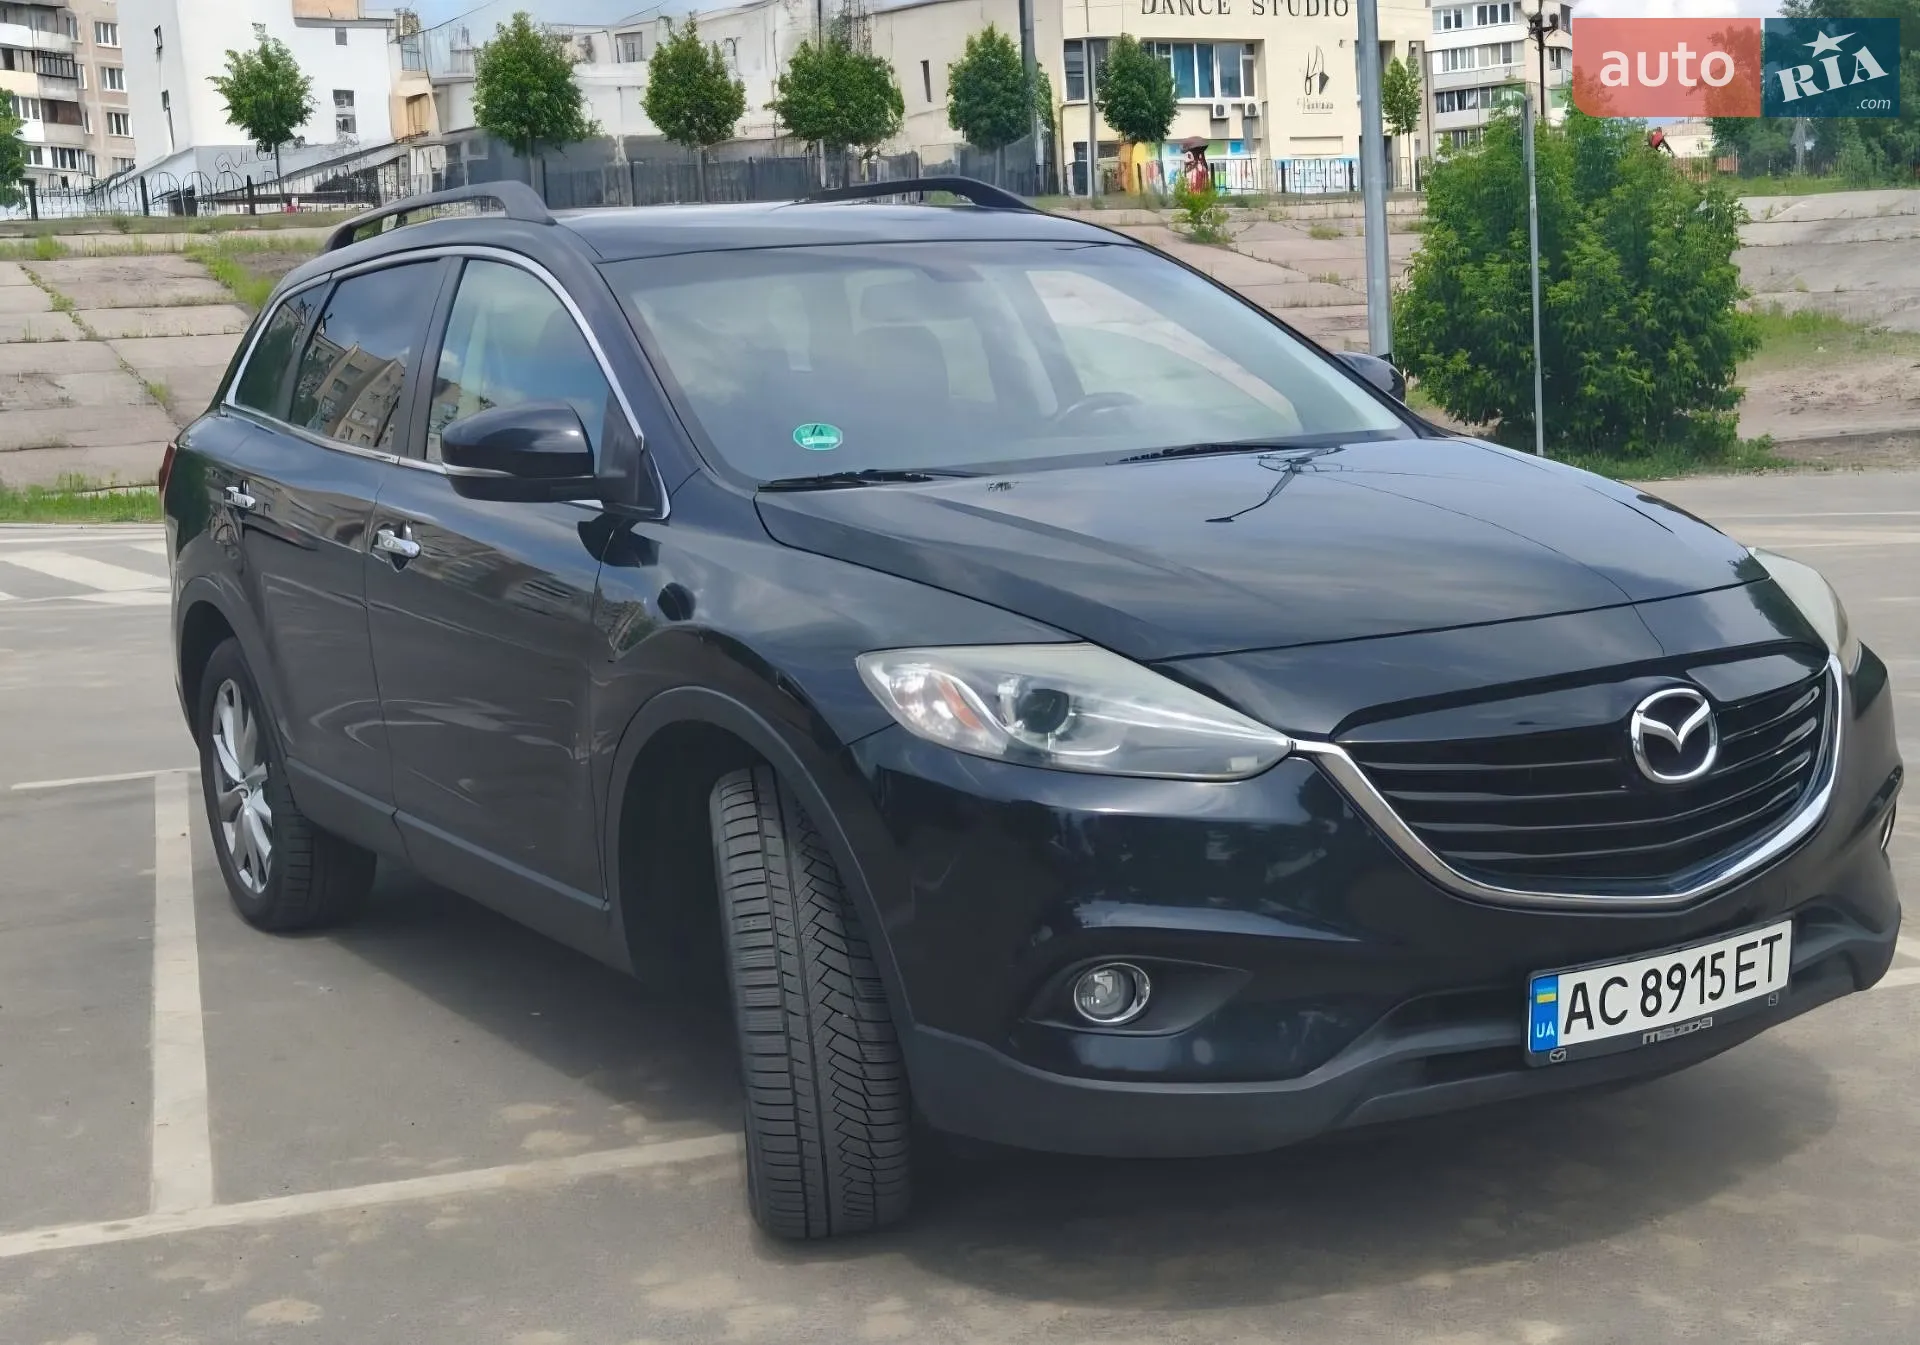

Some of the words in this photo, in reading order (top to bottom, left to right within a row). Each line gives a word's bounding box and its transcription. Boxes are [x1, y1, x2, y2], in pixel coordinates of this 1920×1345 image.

[1141, 0, 1231, 15] DANCE
[1252, 0, 1349, 17] STUDIO
[1536, 1021, 1555, 1038] UA
[1564, 976, 1629, 1035] AC
[1640, 950, 1726, 1018] 8915
[1735, 932, 1783, 993] ET
